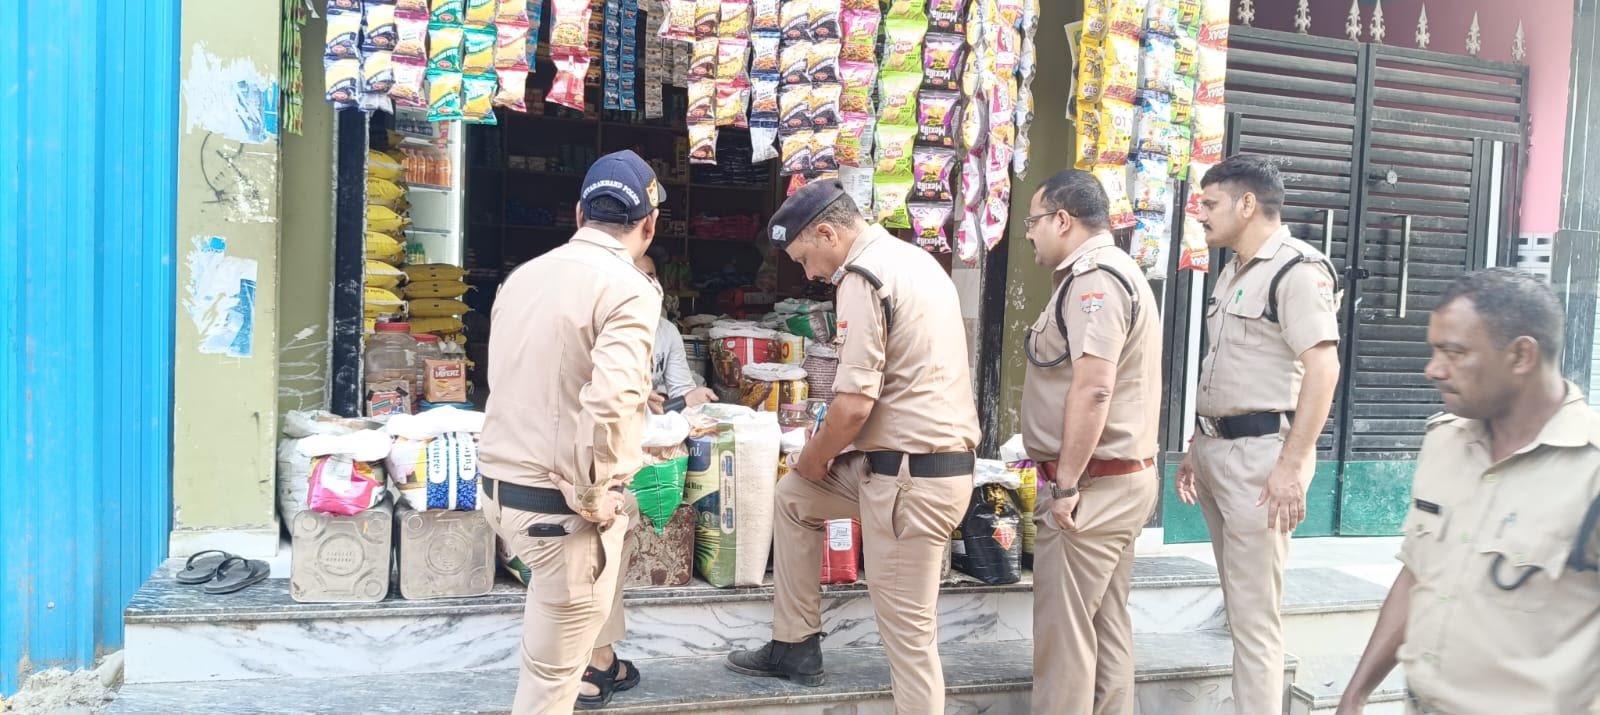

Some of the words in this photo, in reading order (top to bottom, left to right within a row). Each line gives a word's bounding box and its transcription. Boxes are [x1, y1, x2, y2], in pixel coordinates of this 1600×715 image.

[930, 8, 958, 22] Mexilla
[925, 68, 952, 80] Mexilla
[920, 125, 946, 136] Mexilla
[582, 179, 623, 199] UTTARAKHAND
[622, 185, 641, 206] POLICE
[916, 181, 943, 192] Mexilla
[689, 443, 703, 457] ni
